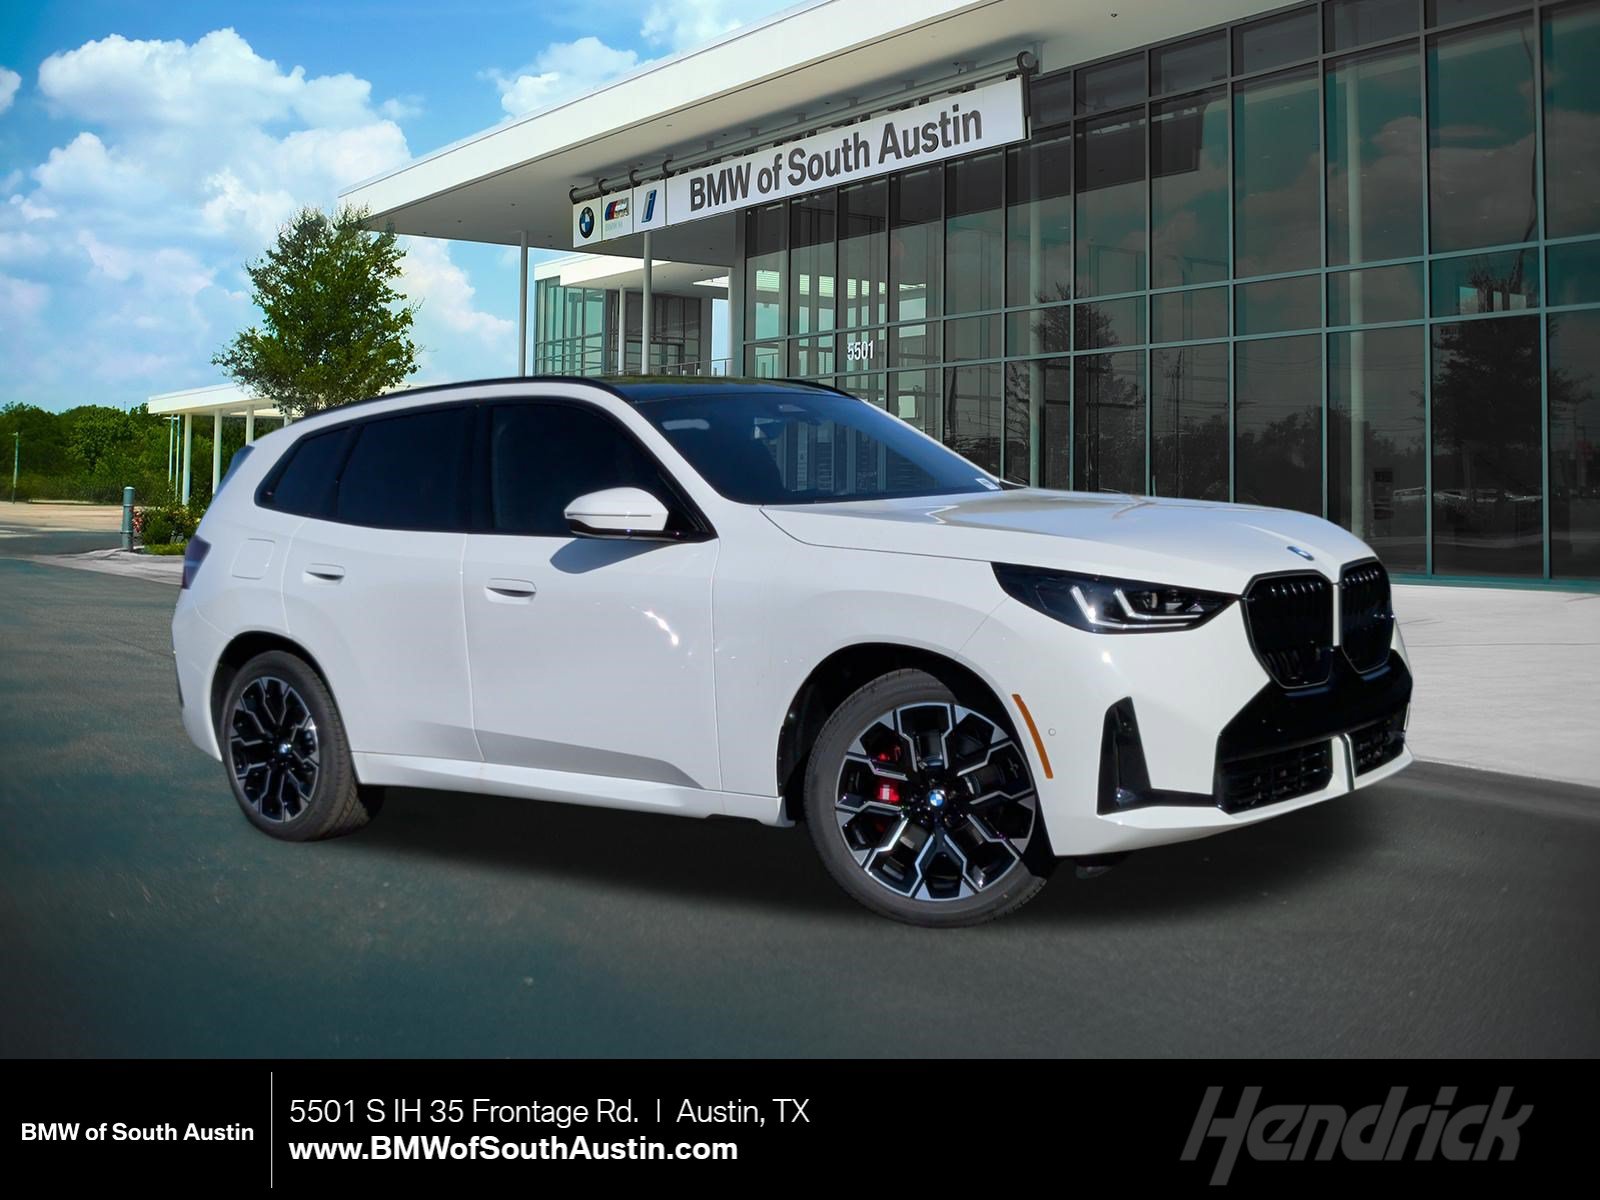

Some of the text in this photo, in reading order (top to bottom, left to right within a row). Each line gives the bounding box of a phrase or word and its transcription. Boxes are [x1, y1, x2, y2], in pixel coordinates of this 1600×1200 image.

[689, 104, 983, 212] BMW of South Austin
[847, 340, 874, 360] 5501
